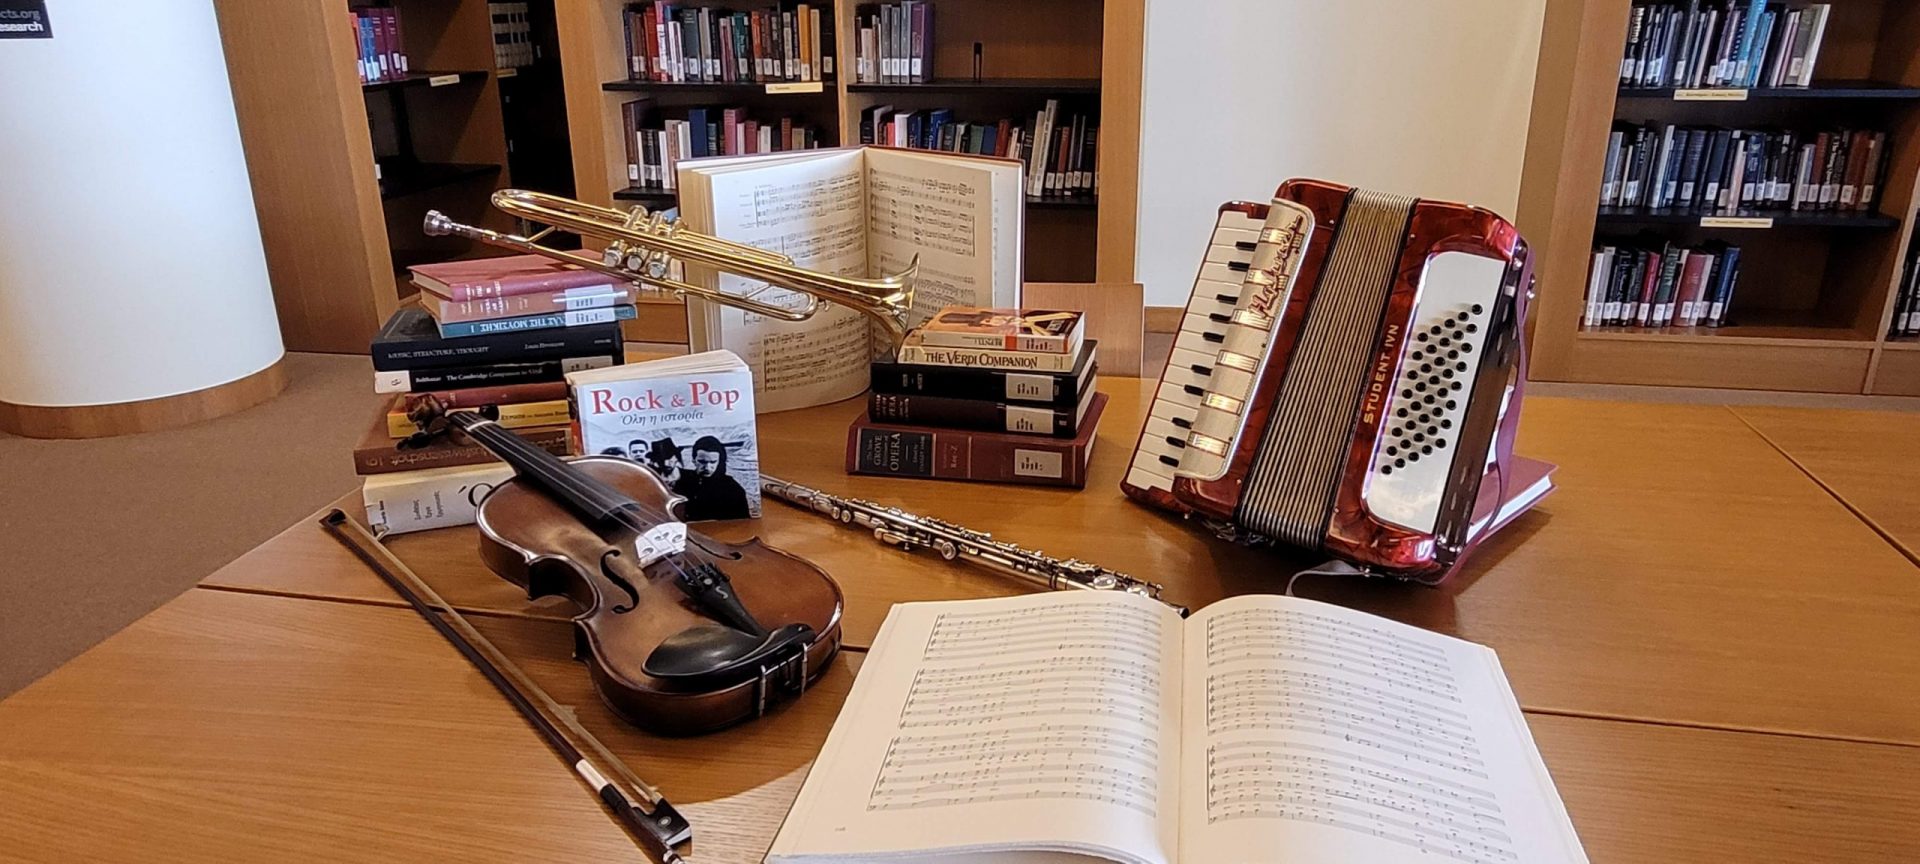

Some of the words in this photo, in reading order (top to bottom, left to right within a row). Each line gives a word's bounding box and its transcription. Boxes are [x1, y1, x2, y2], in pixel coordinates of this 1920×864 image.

[480, 320, 528, 333] ΜΟΥΣΙΚΗΣ
[924, 352, 945, 363] THE
[945, 350, 978, 366] VERDI
[979, 353, 1038, 369] COMPANION
[590, 388, 665, 415] Rock
[670, 393, 686, 408] &
[688, 381, 740, 411] Pop
[1363, 352, 1391, 424] STUDENT
[620, 413, 647, 426] Όλη
[649, 415, 658, 426] η
[660, 410, 704, 423] ιστορία
[873, 435, 883, 466] GROVE
[889, 433, 901, 471] OPERA
